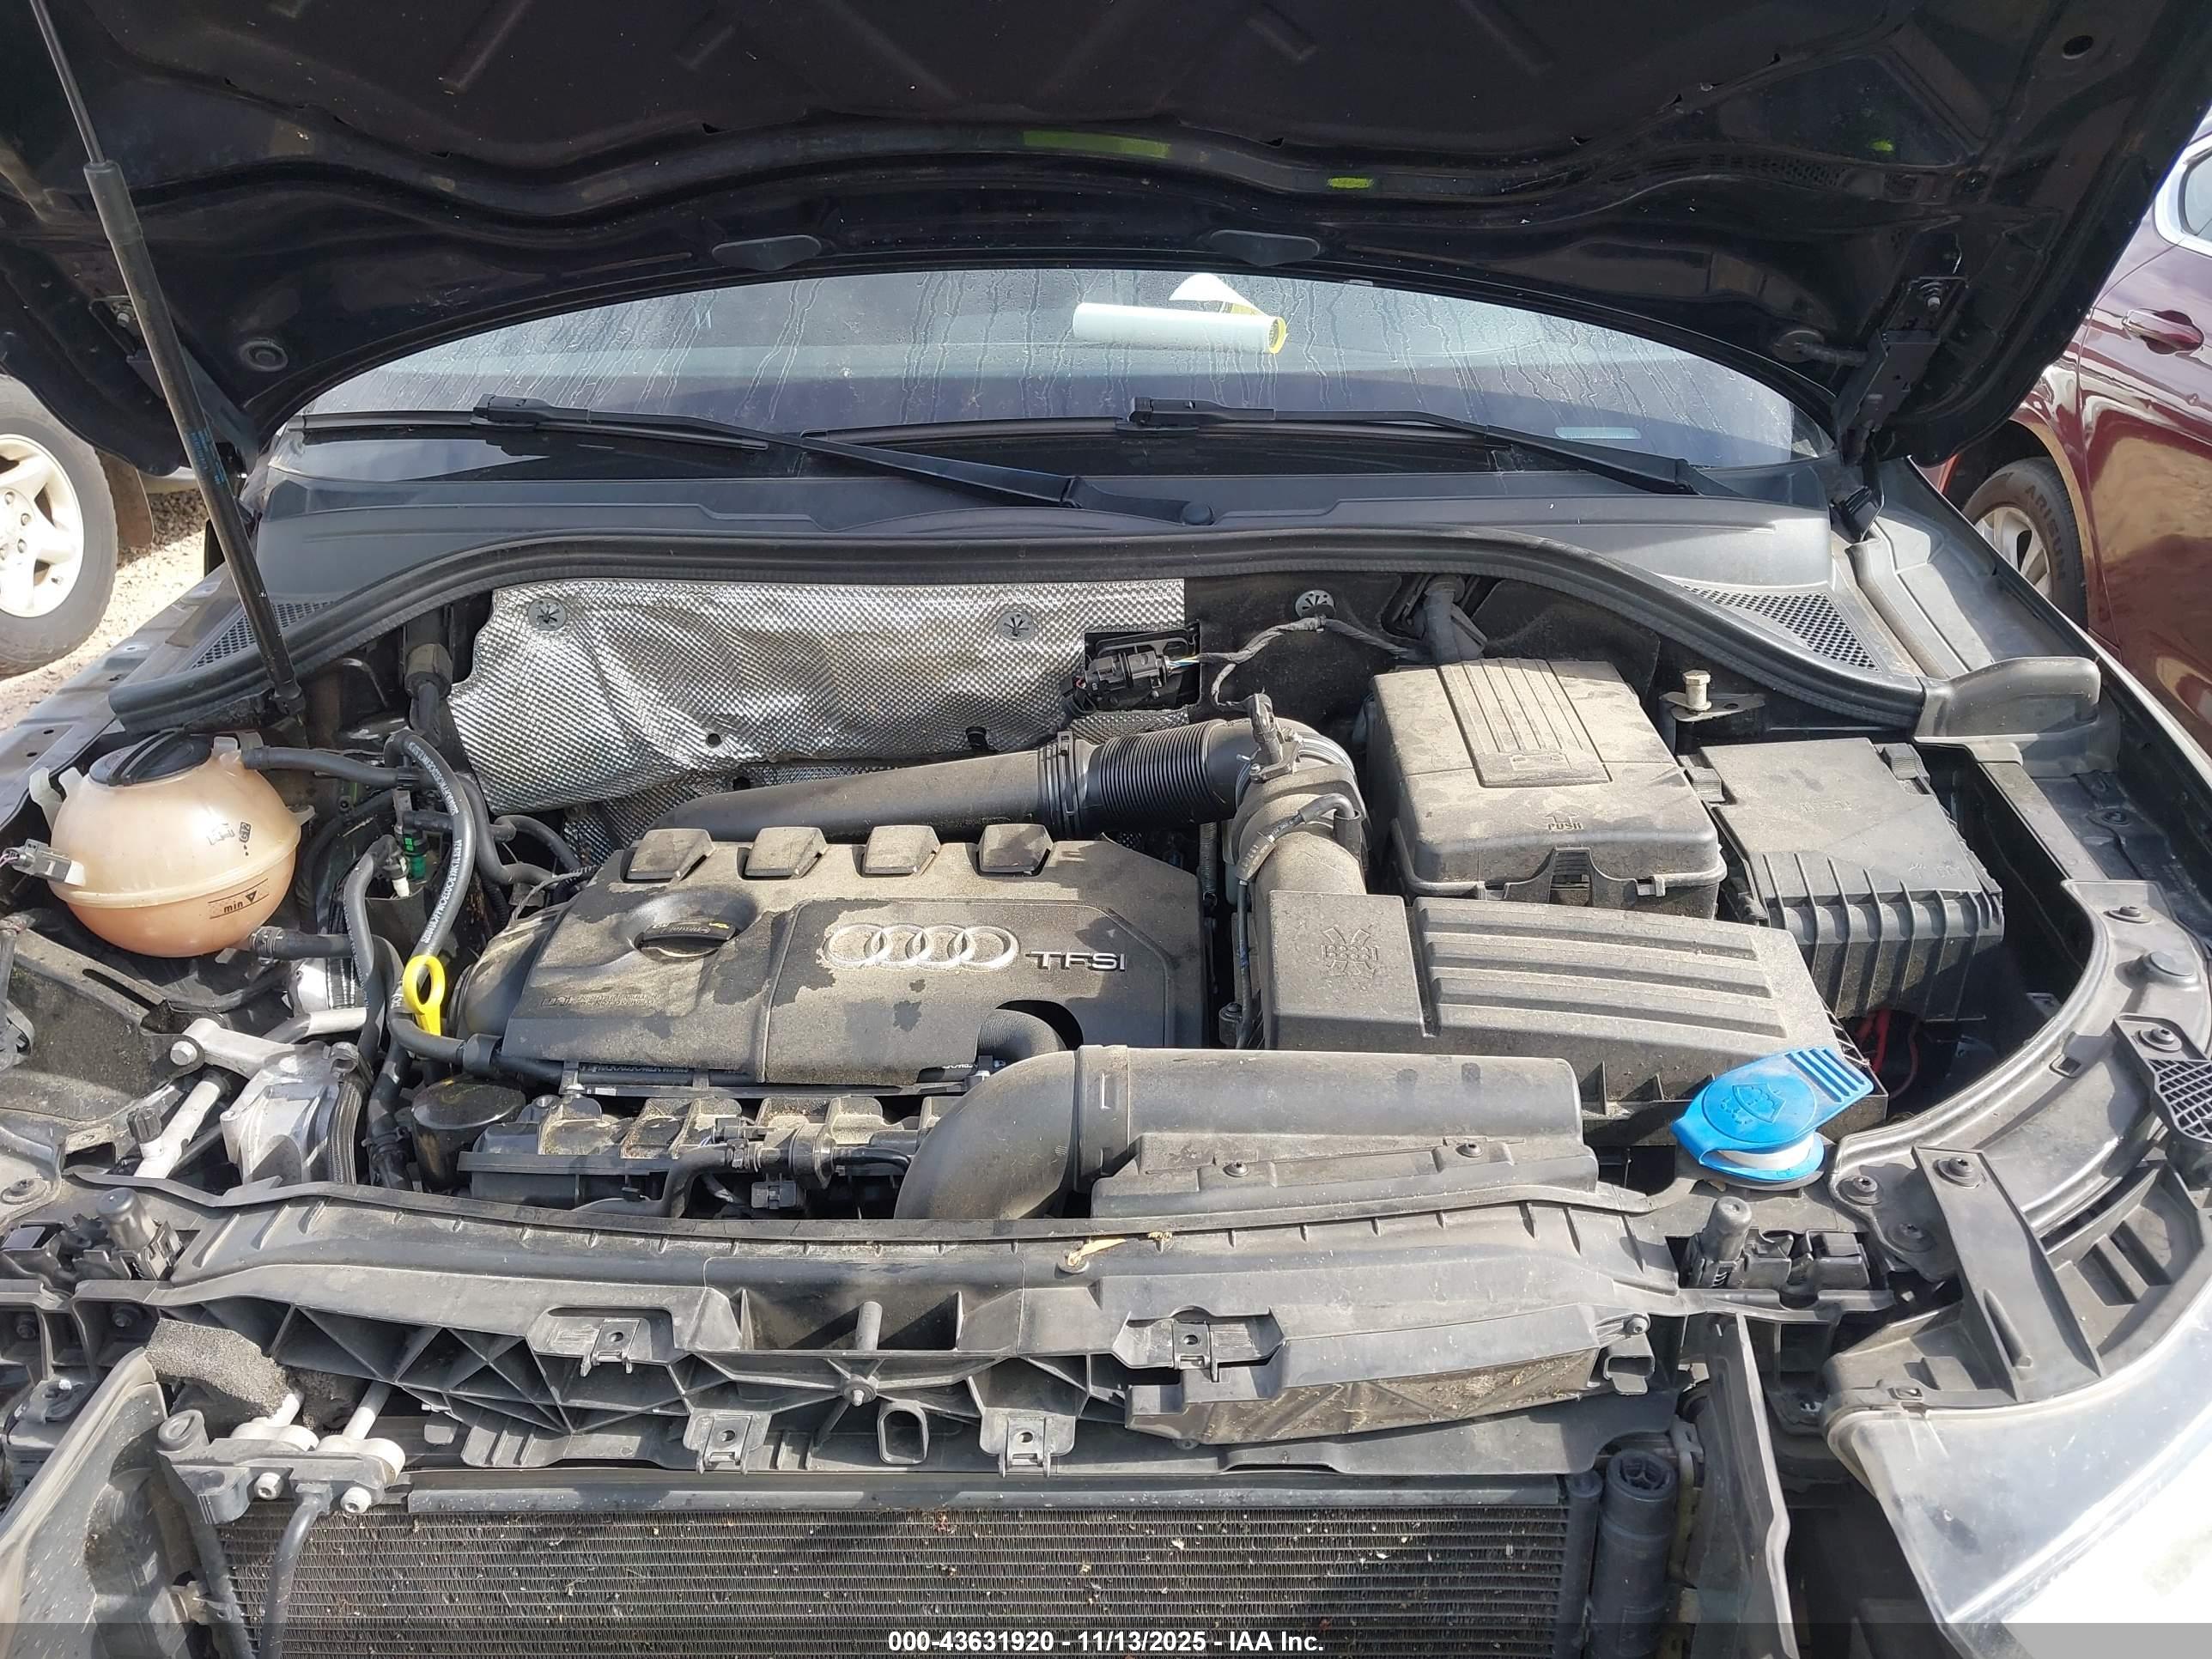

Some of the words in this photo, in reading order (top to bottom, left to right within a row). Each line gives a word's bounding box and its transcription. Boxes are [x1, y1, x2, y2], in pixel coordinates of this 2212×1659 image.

[1547, 822, 1583, 831] PUSH
[222, 900, 245, 915] min
[1026, 951, 1127, 972] TFSI
